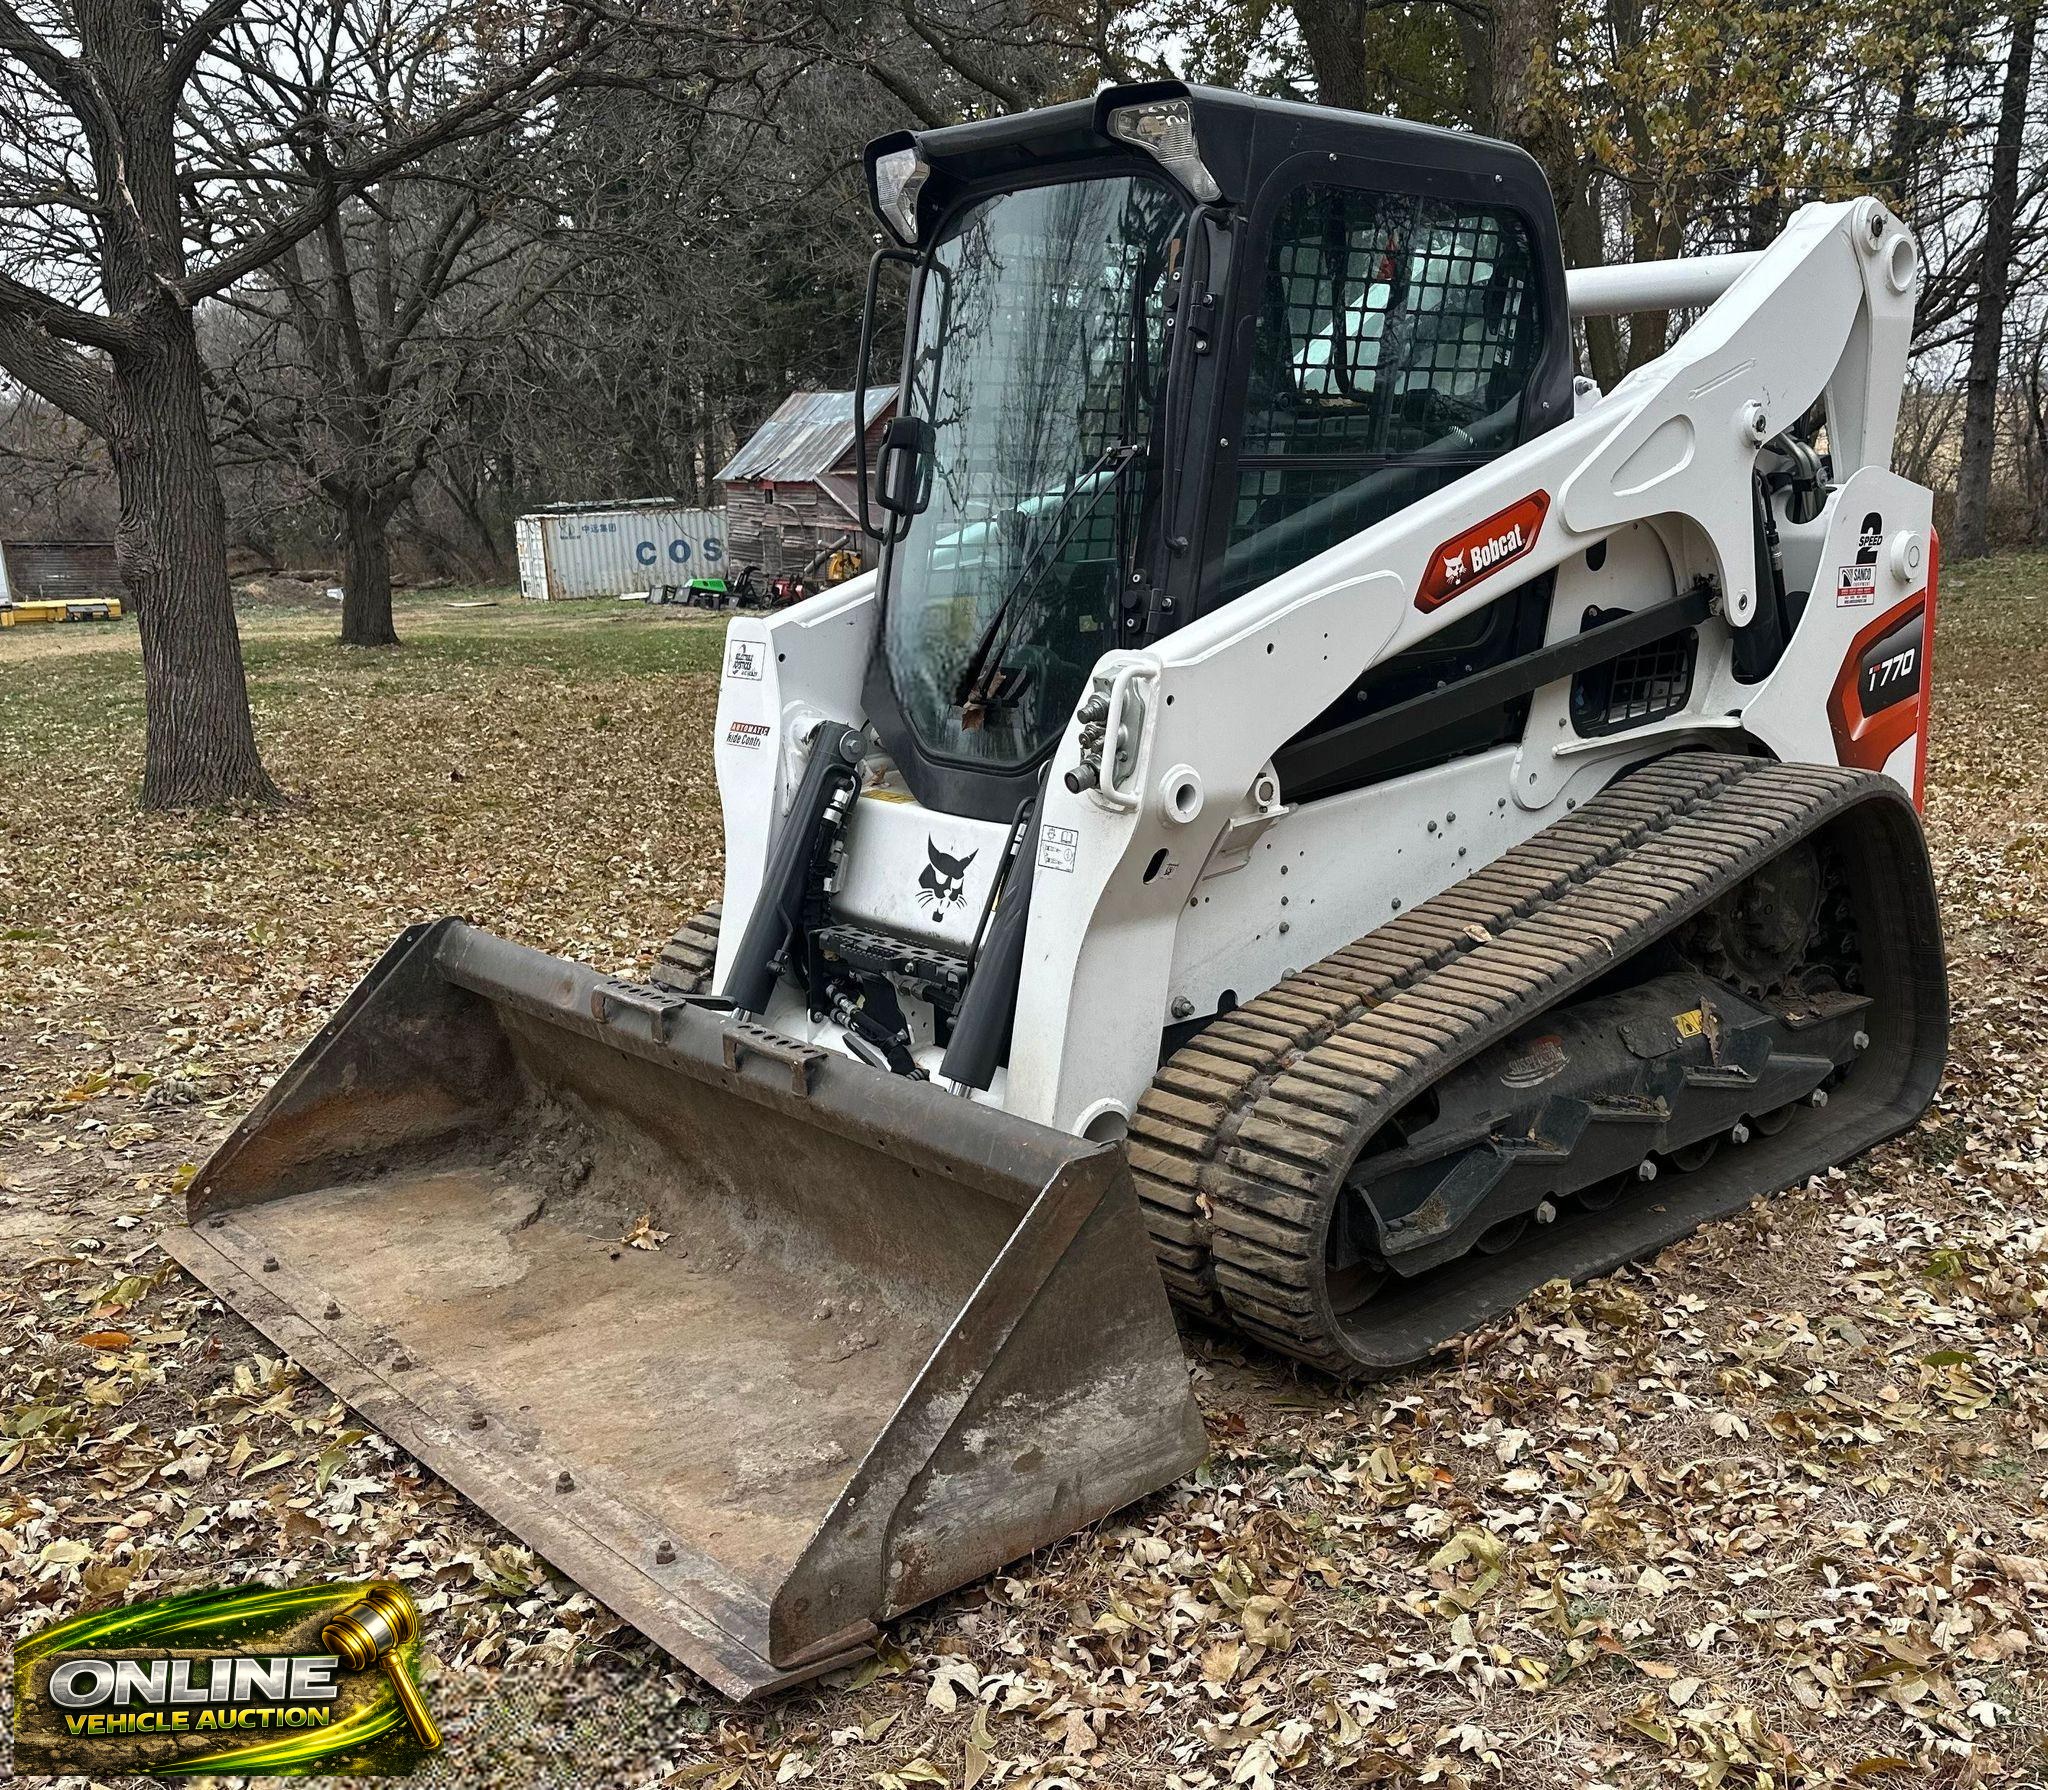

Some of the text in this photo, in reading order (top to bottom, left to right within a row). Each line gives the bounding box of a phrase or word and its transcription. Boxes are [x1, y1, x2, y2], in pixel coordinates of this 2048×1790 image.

[1470, 523, 1523, 573] Bobcat
[1859, 535, 1883, 547] SPEED
[1869, 648, 1915, 691] T770
